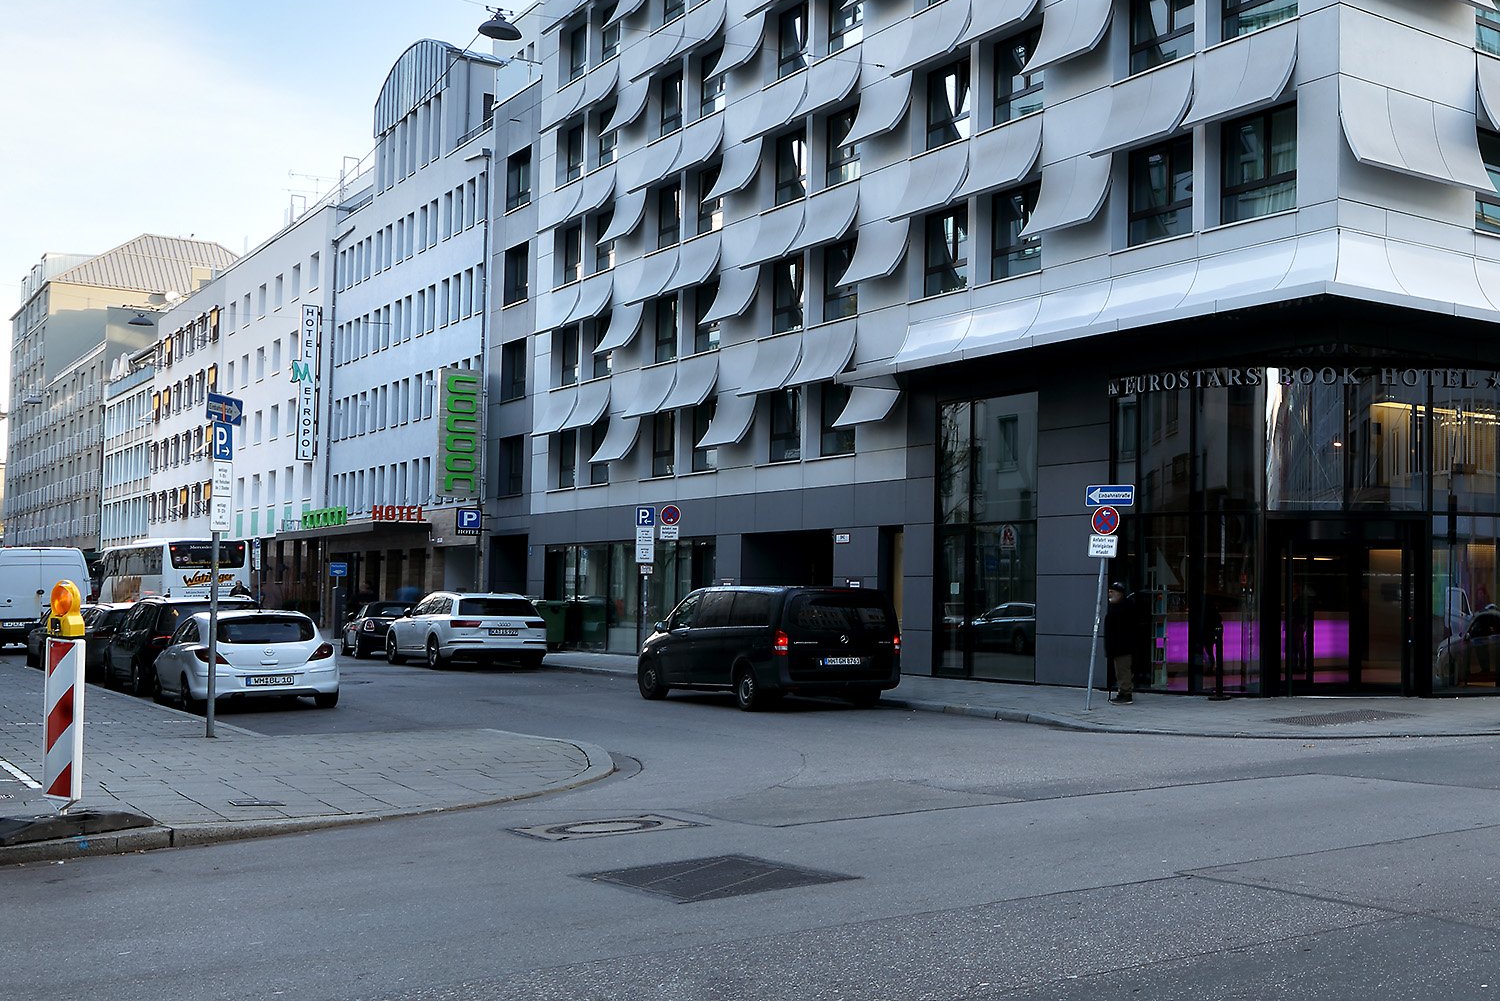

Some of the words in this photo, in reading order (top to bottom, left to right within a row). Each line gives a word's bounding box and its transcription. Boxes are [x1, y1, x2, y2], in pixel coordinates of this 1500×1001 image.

[305, 308, 314, 358] HOTEL
[1120, 366, 1261, 395] EUROSTARS
[1277, 366, 1361, 386] BOOK
[1380, 367, 1479, 389] HOTEL
[292, 362, 314, 458] METROPOL
[216, 427, 228, 455] P
[371, 504, 427, 521] HOTEL
[463, 511, 477, 526] P
[640, 509, 650, 524] P
